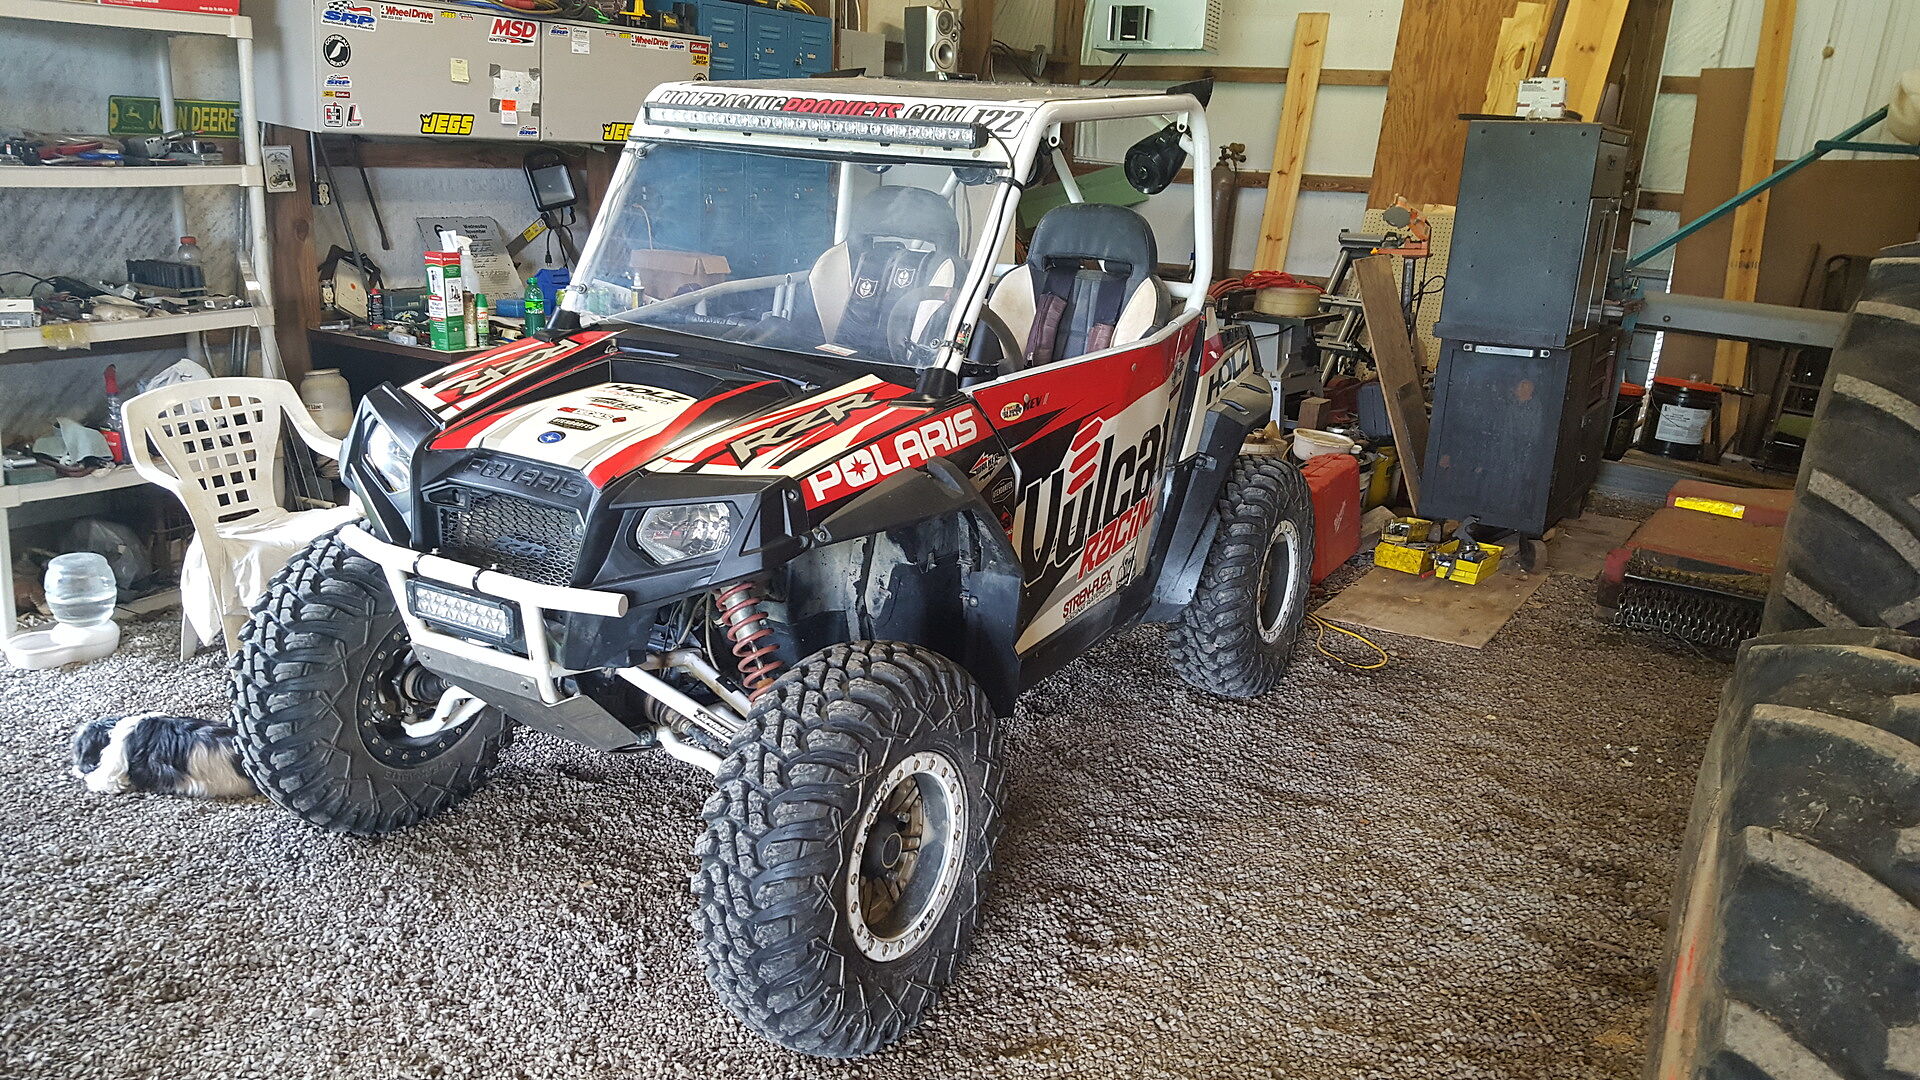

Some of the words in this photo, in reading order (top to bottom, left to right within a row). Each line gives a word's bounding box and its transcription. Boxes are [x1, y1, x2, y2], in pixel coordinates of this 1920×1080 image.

[323, 10, 376, 25] SRP
[492, 18, 537, 38] MSD
[191, 106, 236, 132] DEERE
[421, 113, 475, 135] JEGS
[970, 108, 1025, 133] 122
[607, 385, 690, 403] HOLZ
[729, 392, 881, 464] RZR
[806, 408, 978, 502] POLARIS
[463, 458, 583, 498] POLARIS
